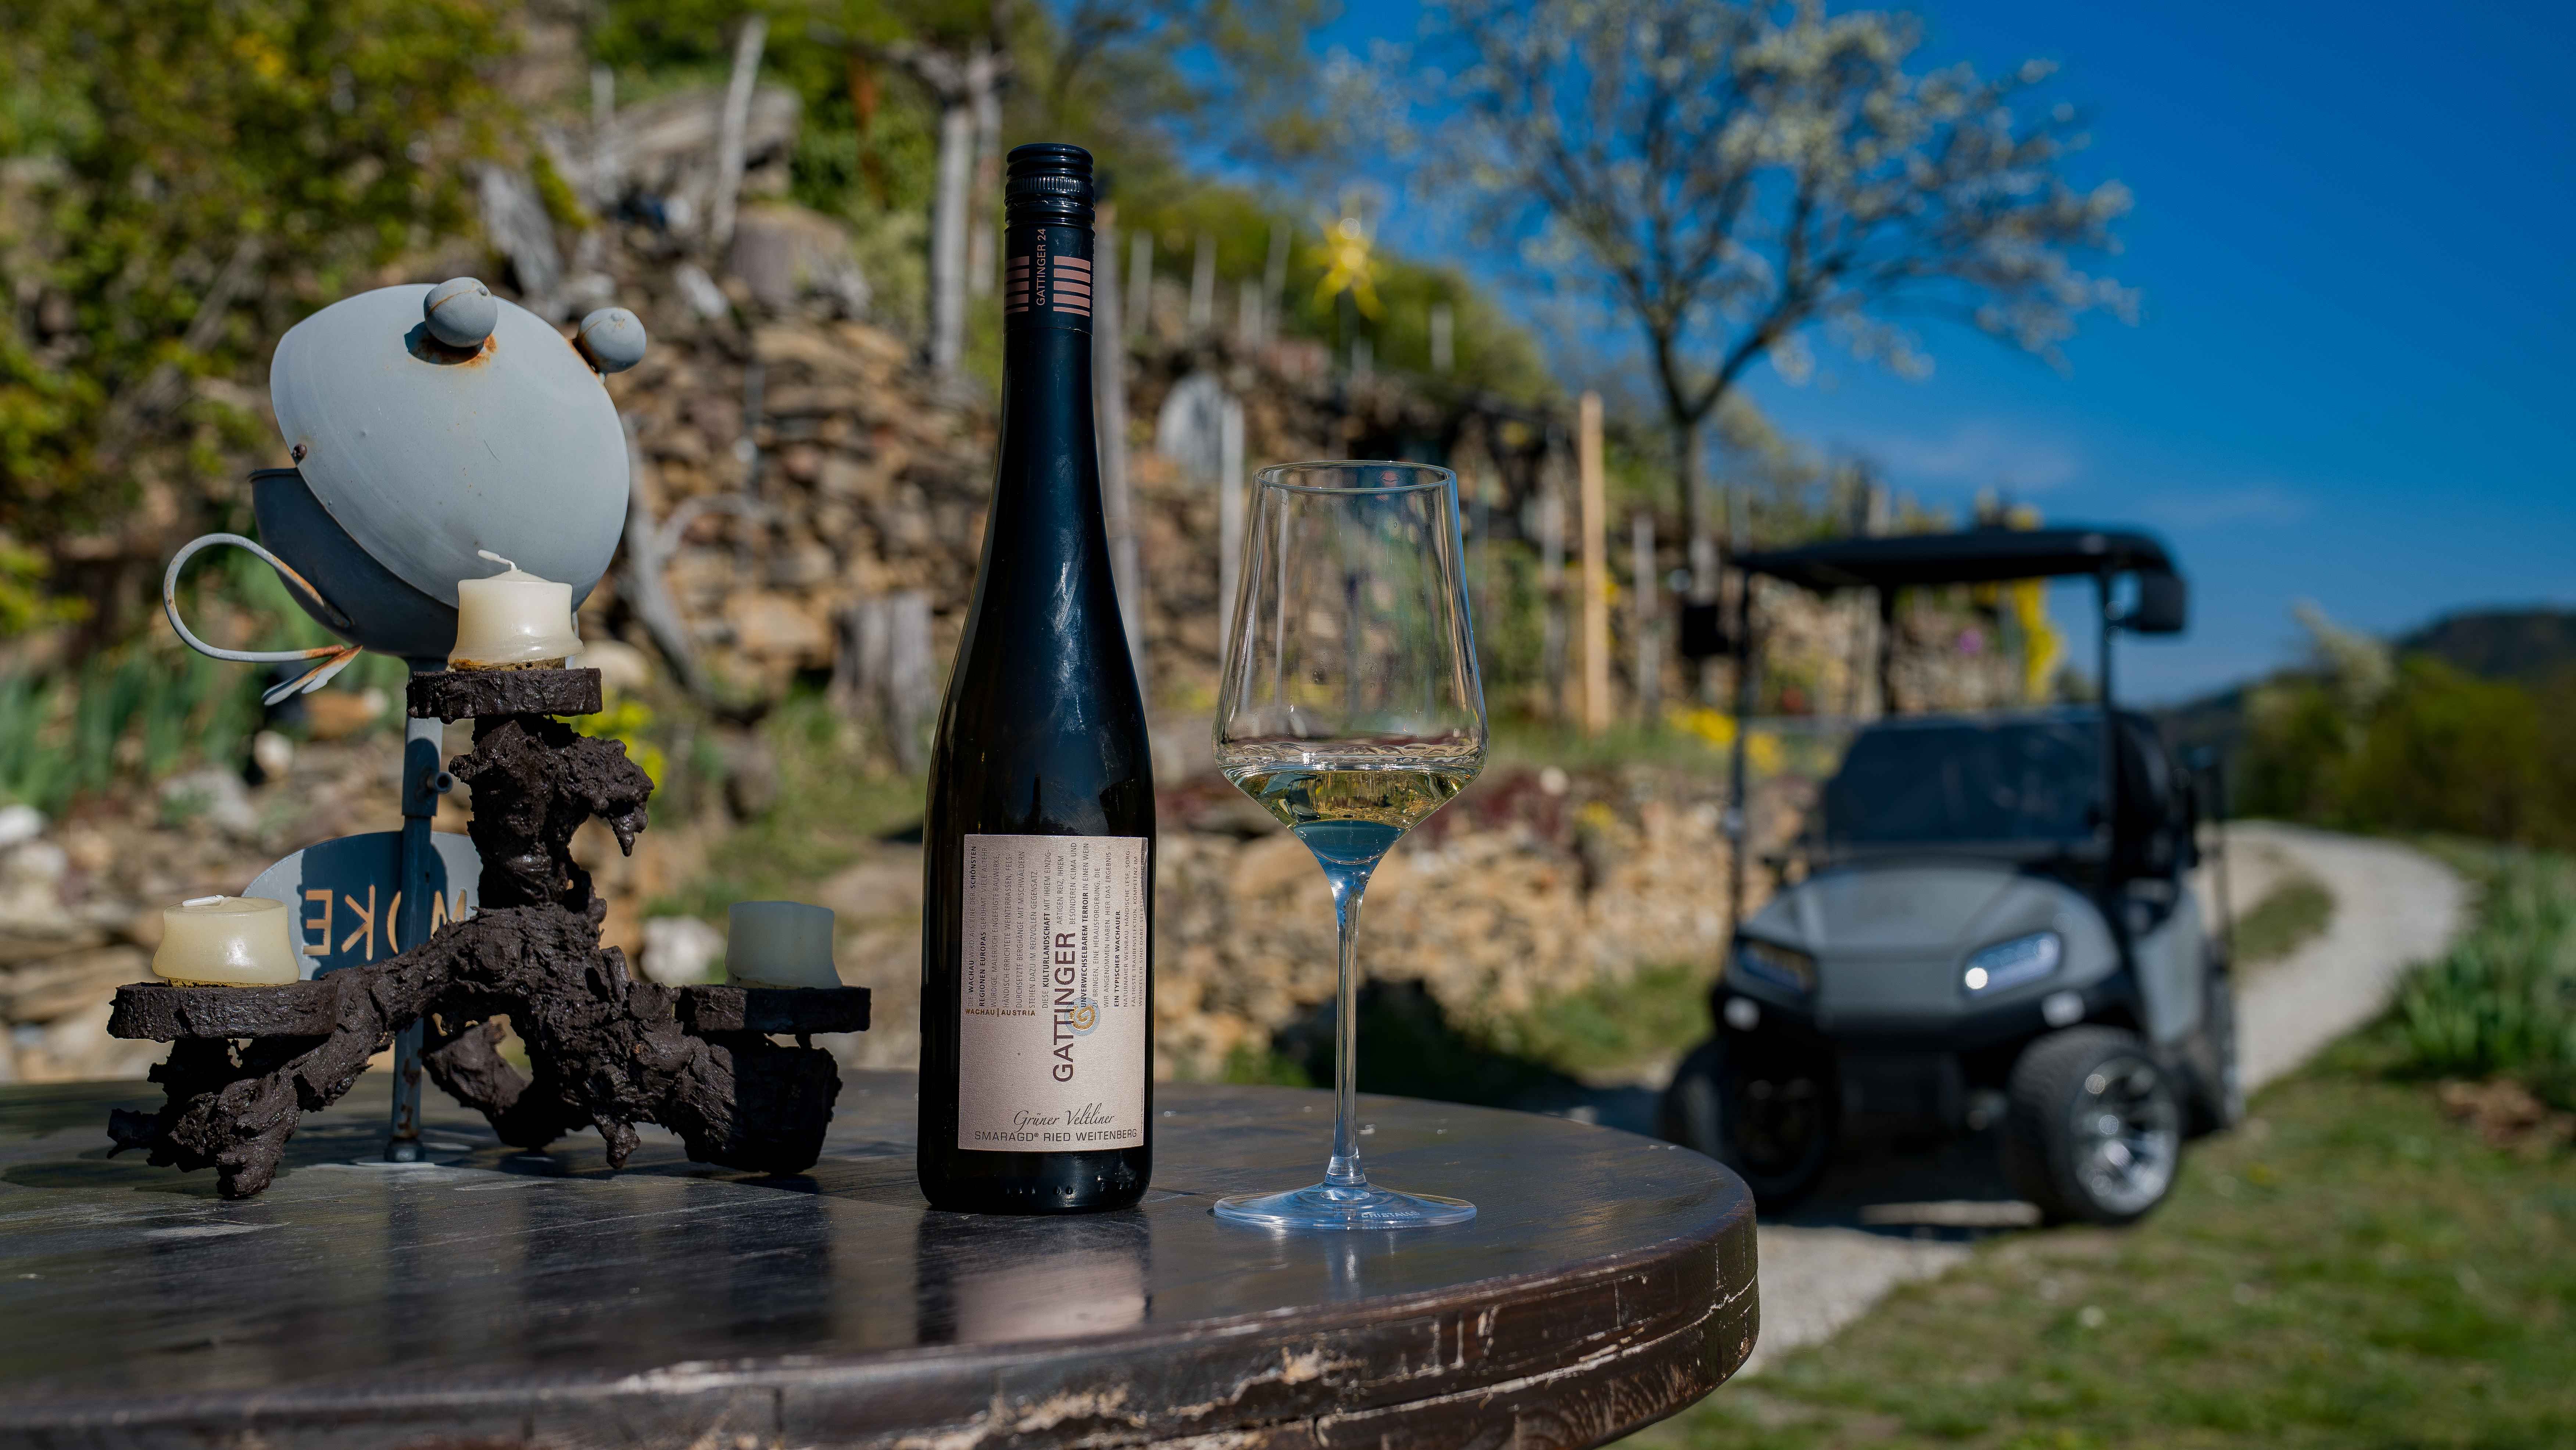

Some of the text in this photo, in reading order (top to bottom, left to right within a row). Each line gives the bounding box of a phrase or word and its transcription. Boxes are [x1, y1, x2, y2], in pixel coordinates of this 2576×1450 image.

[1036, 228, 1046, 306] GATTINGER 24
[1053, 932, 1076, 1082] GATTINGER
[1013, 1103, 1115, 1132] Grüner Veltliner
[1043, 1132, 1071, 1142] RIED
[1076, 1129, 1137, 1141] WEITENBERG
